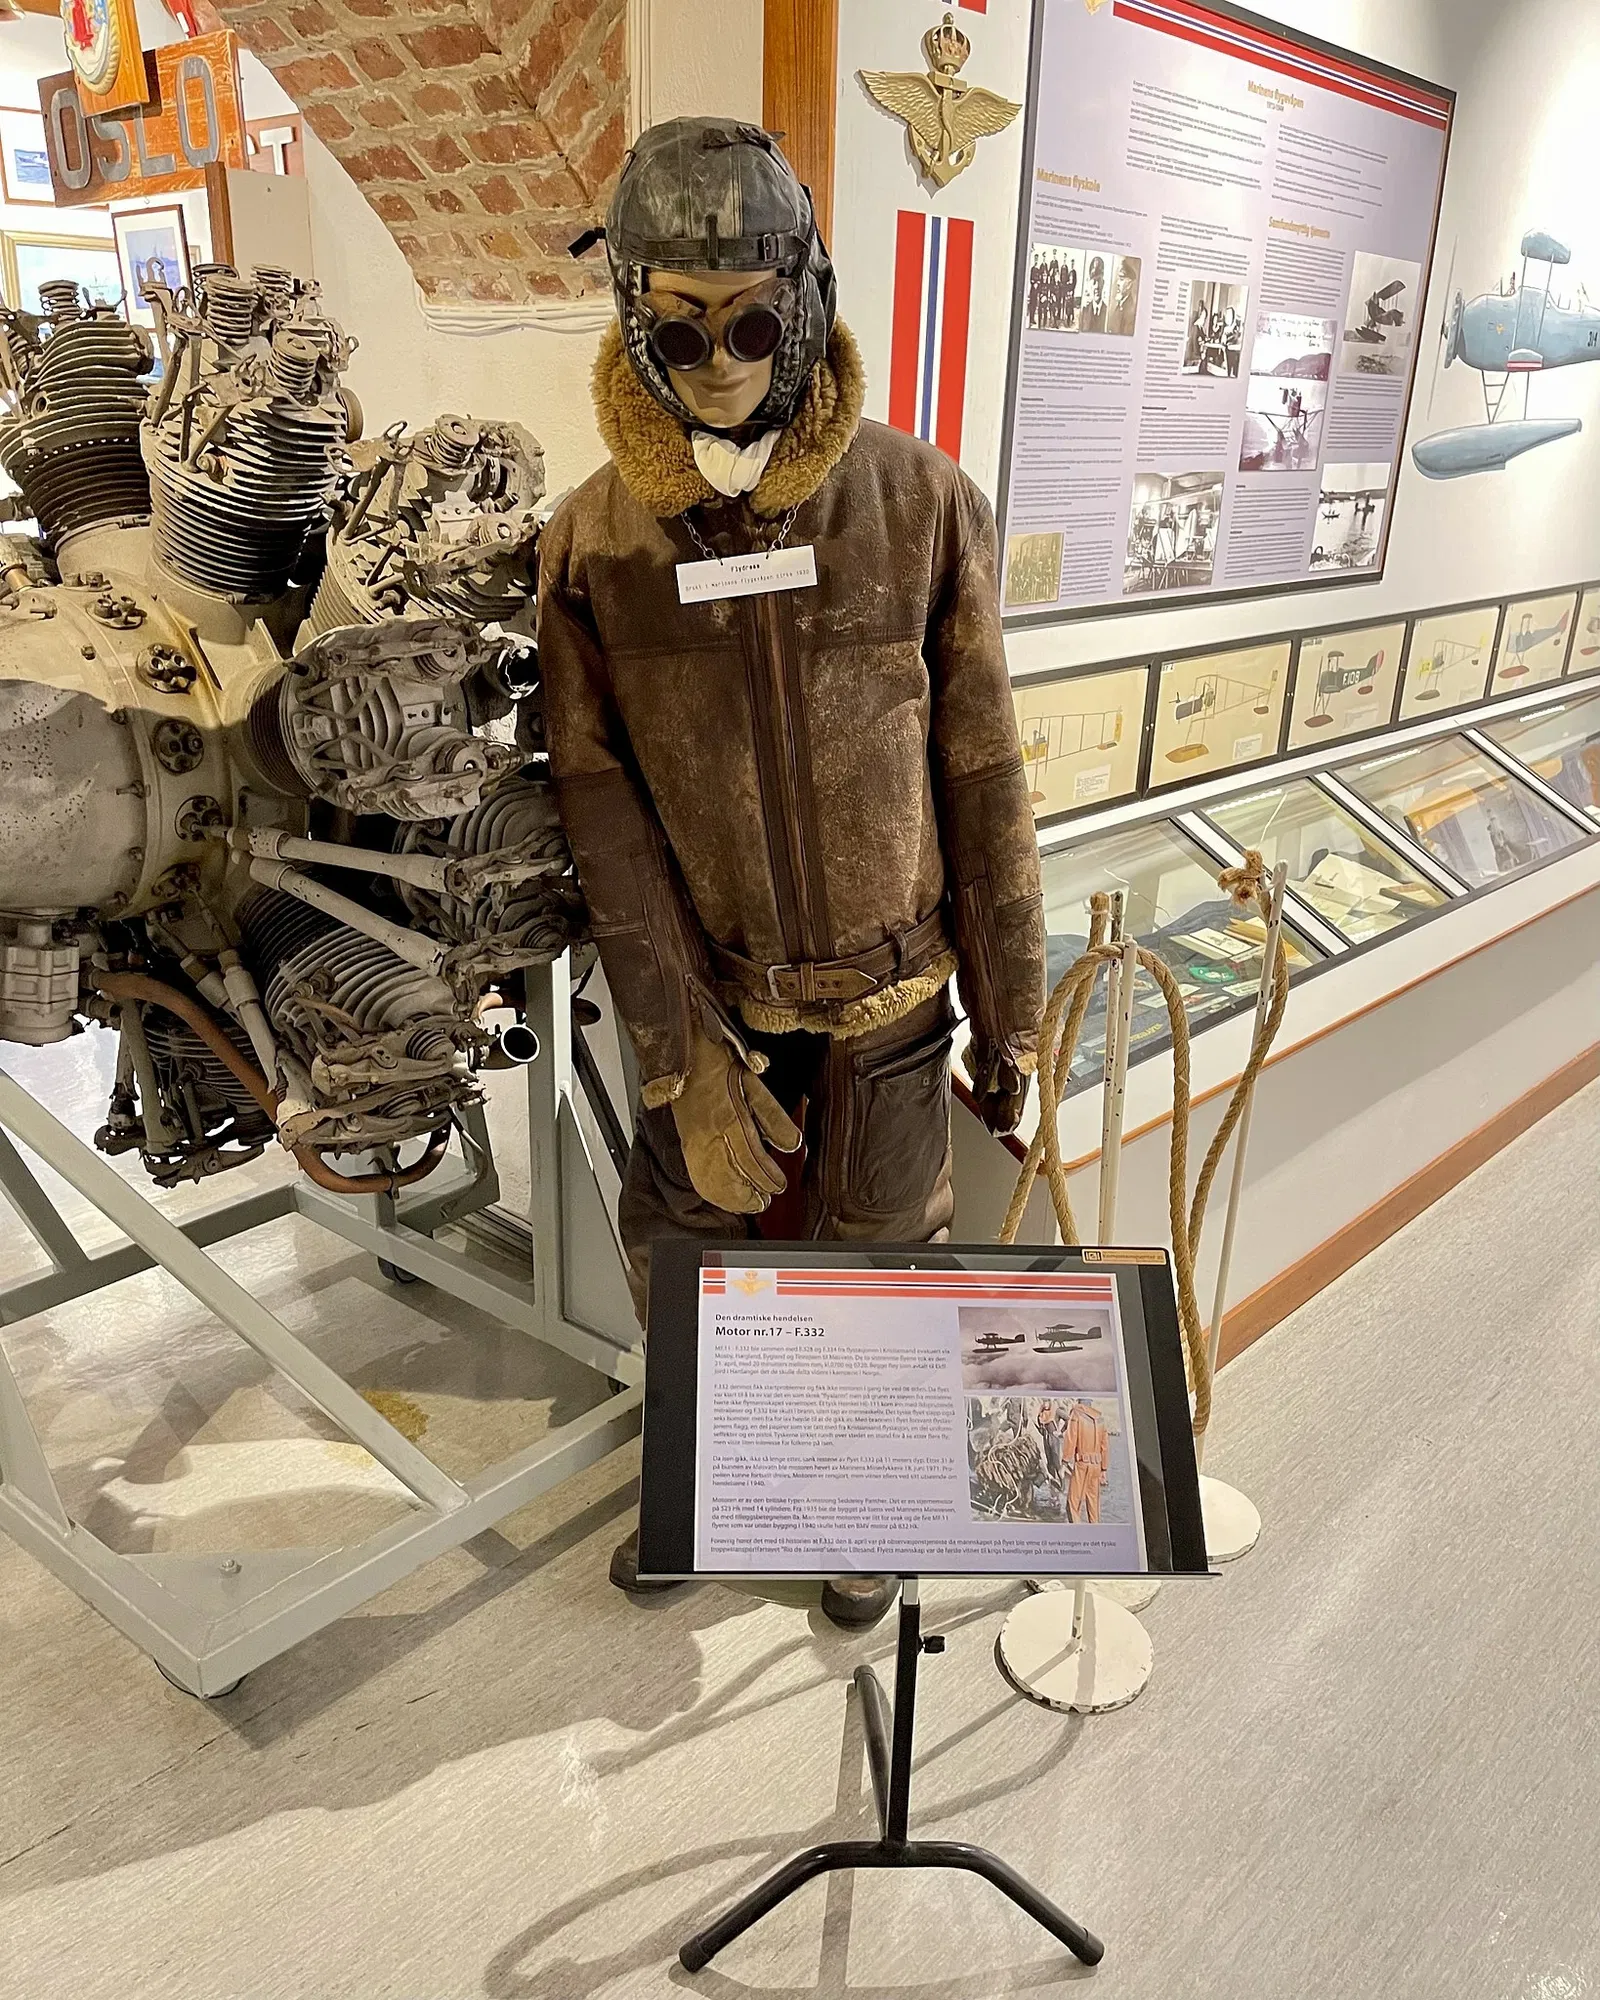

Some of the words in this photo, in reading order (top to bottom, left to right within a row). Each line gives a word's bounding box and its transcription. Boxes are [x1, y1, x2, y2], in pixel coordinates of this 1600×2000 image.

[50, 55, 221, 190] OSLO
[732, 1314, 772, 1322] dramtiske
[715, 1326, 751, 1337] Motor
[753, 1327, 783, 1337] nr.17
[794, 1327, 825, 1337] F.332
